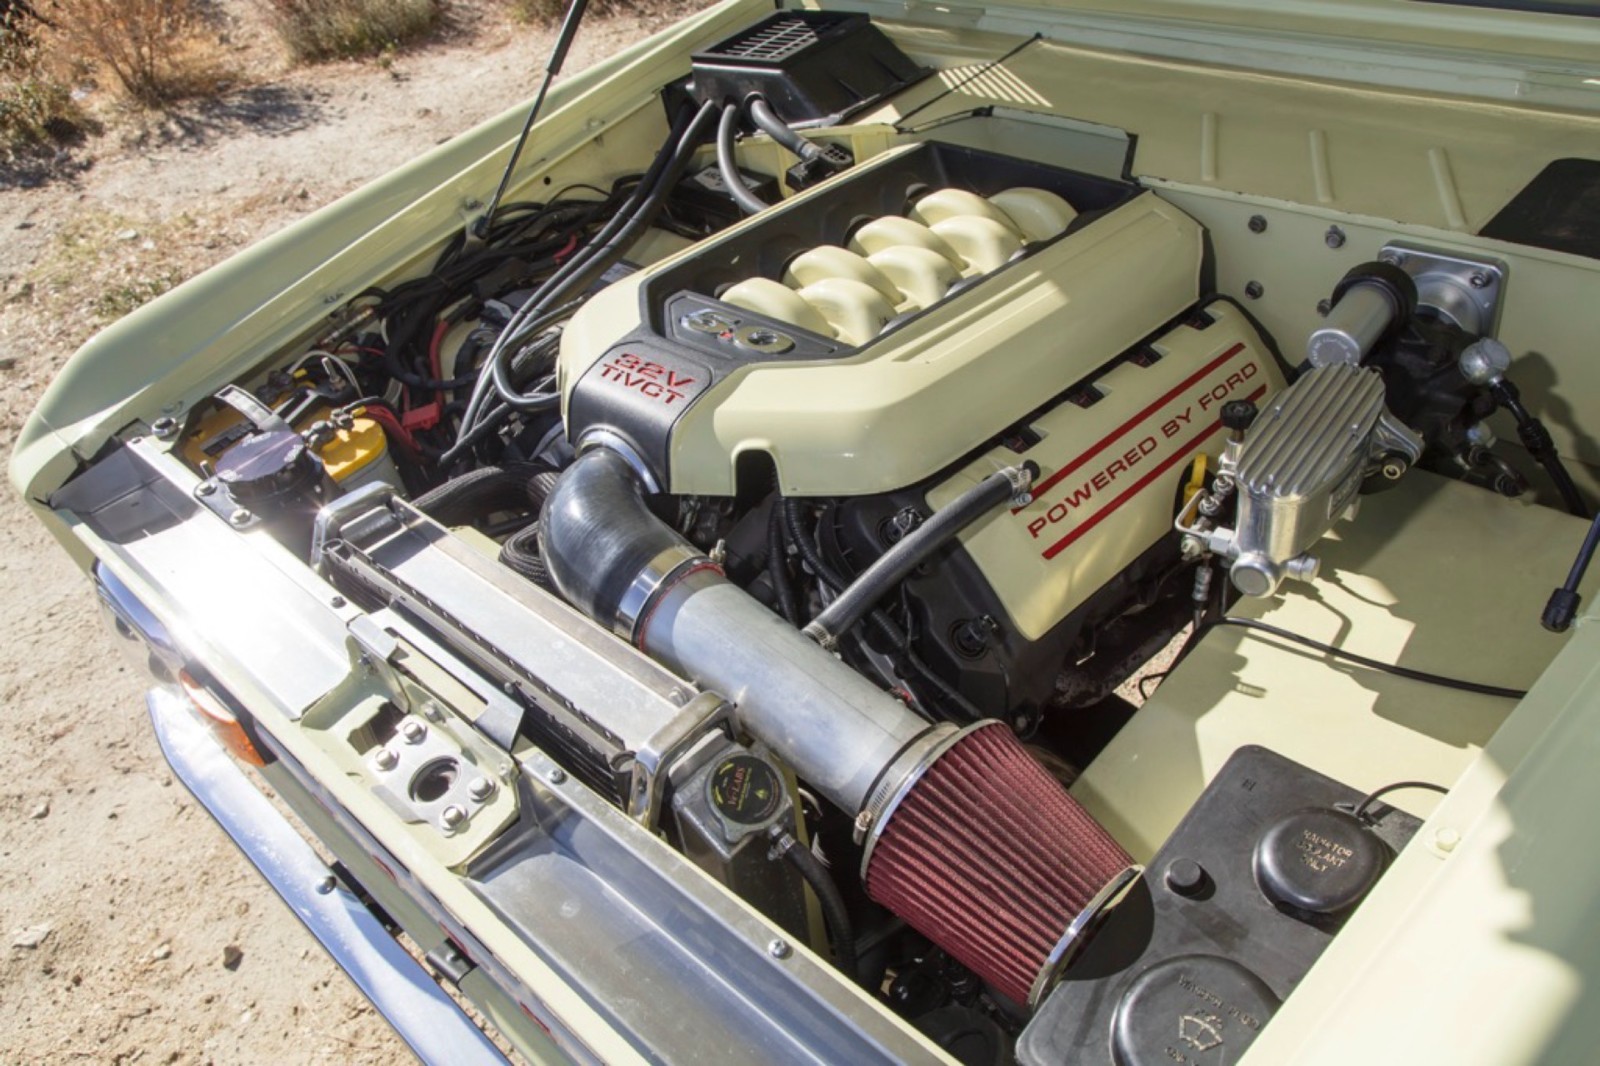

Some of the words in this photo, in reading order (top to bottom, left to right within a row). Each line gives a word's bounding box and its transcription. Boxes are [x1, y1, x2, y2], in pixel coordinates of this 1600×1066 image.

[615, 353, 696, 388] 32V
[1027, 436, 1158, 538] POWERED
[1160, 406, 1193, 438] BY
[1197, 361, 1259, 411] FORD
